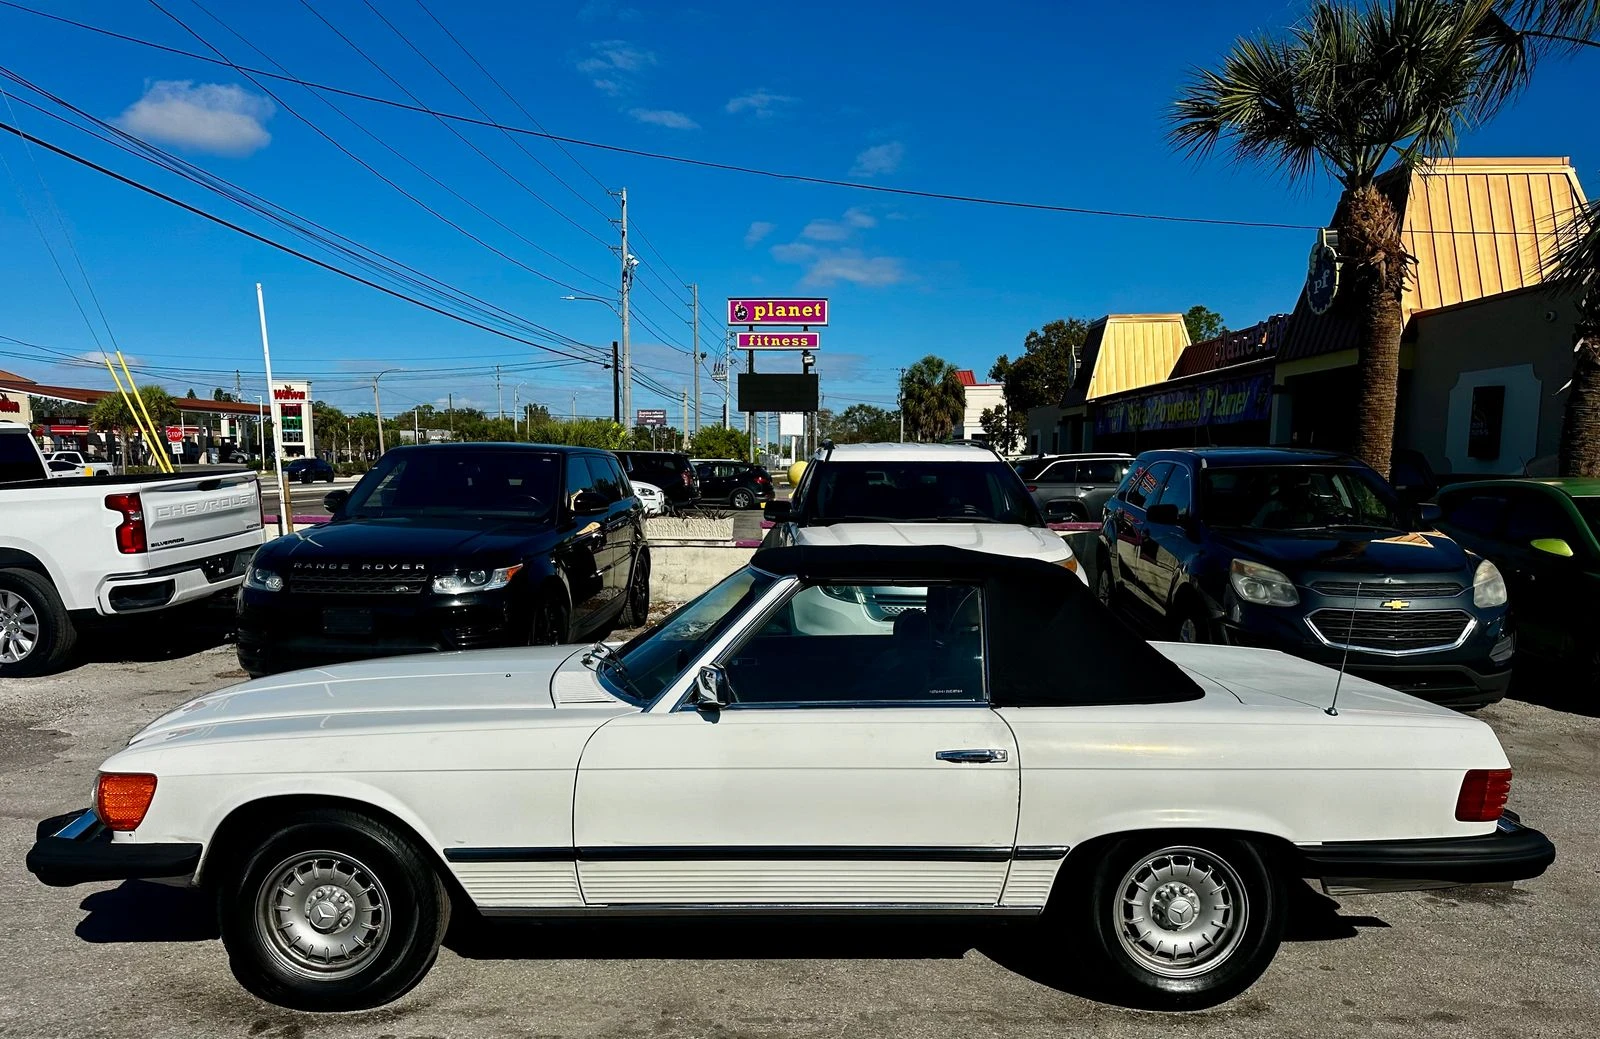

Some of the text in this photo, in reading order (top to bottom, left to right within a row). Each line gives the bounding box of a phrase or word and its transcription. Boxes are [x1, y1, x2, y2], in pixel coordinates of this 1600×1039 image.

[1313, 269, 1330, 295] pf
[753, 302, 821, 321] planet
[748, 335, 808, 346] fitness
[274, 389, 305, 400] Wawa
[156, 492, 257, 519] CHEVROLET
[151, 537, 185, 548] SILVERADO
[293, 562, 351, 570] RANGE
